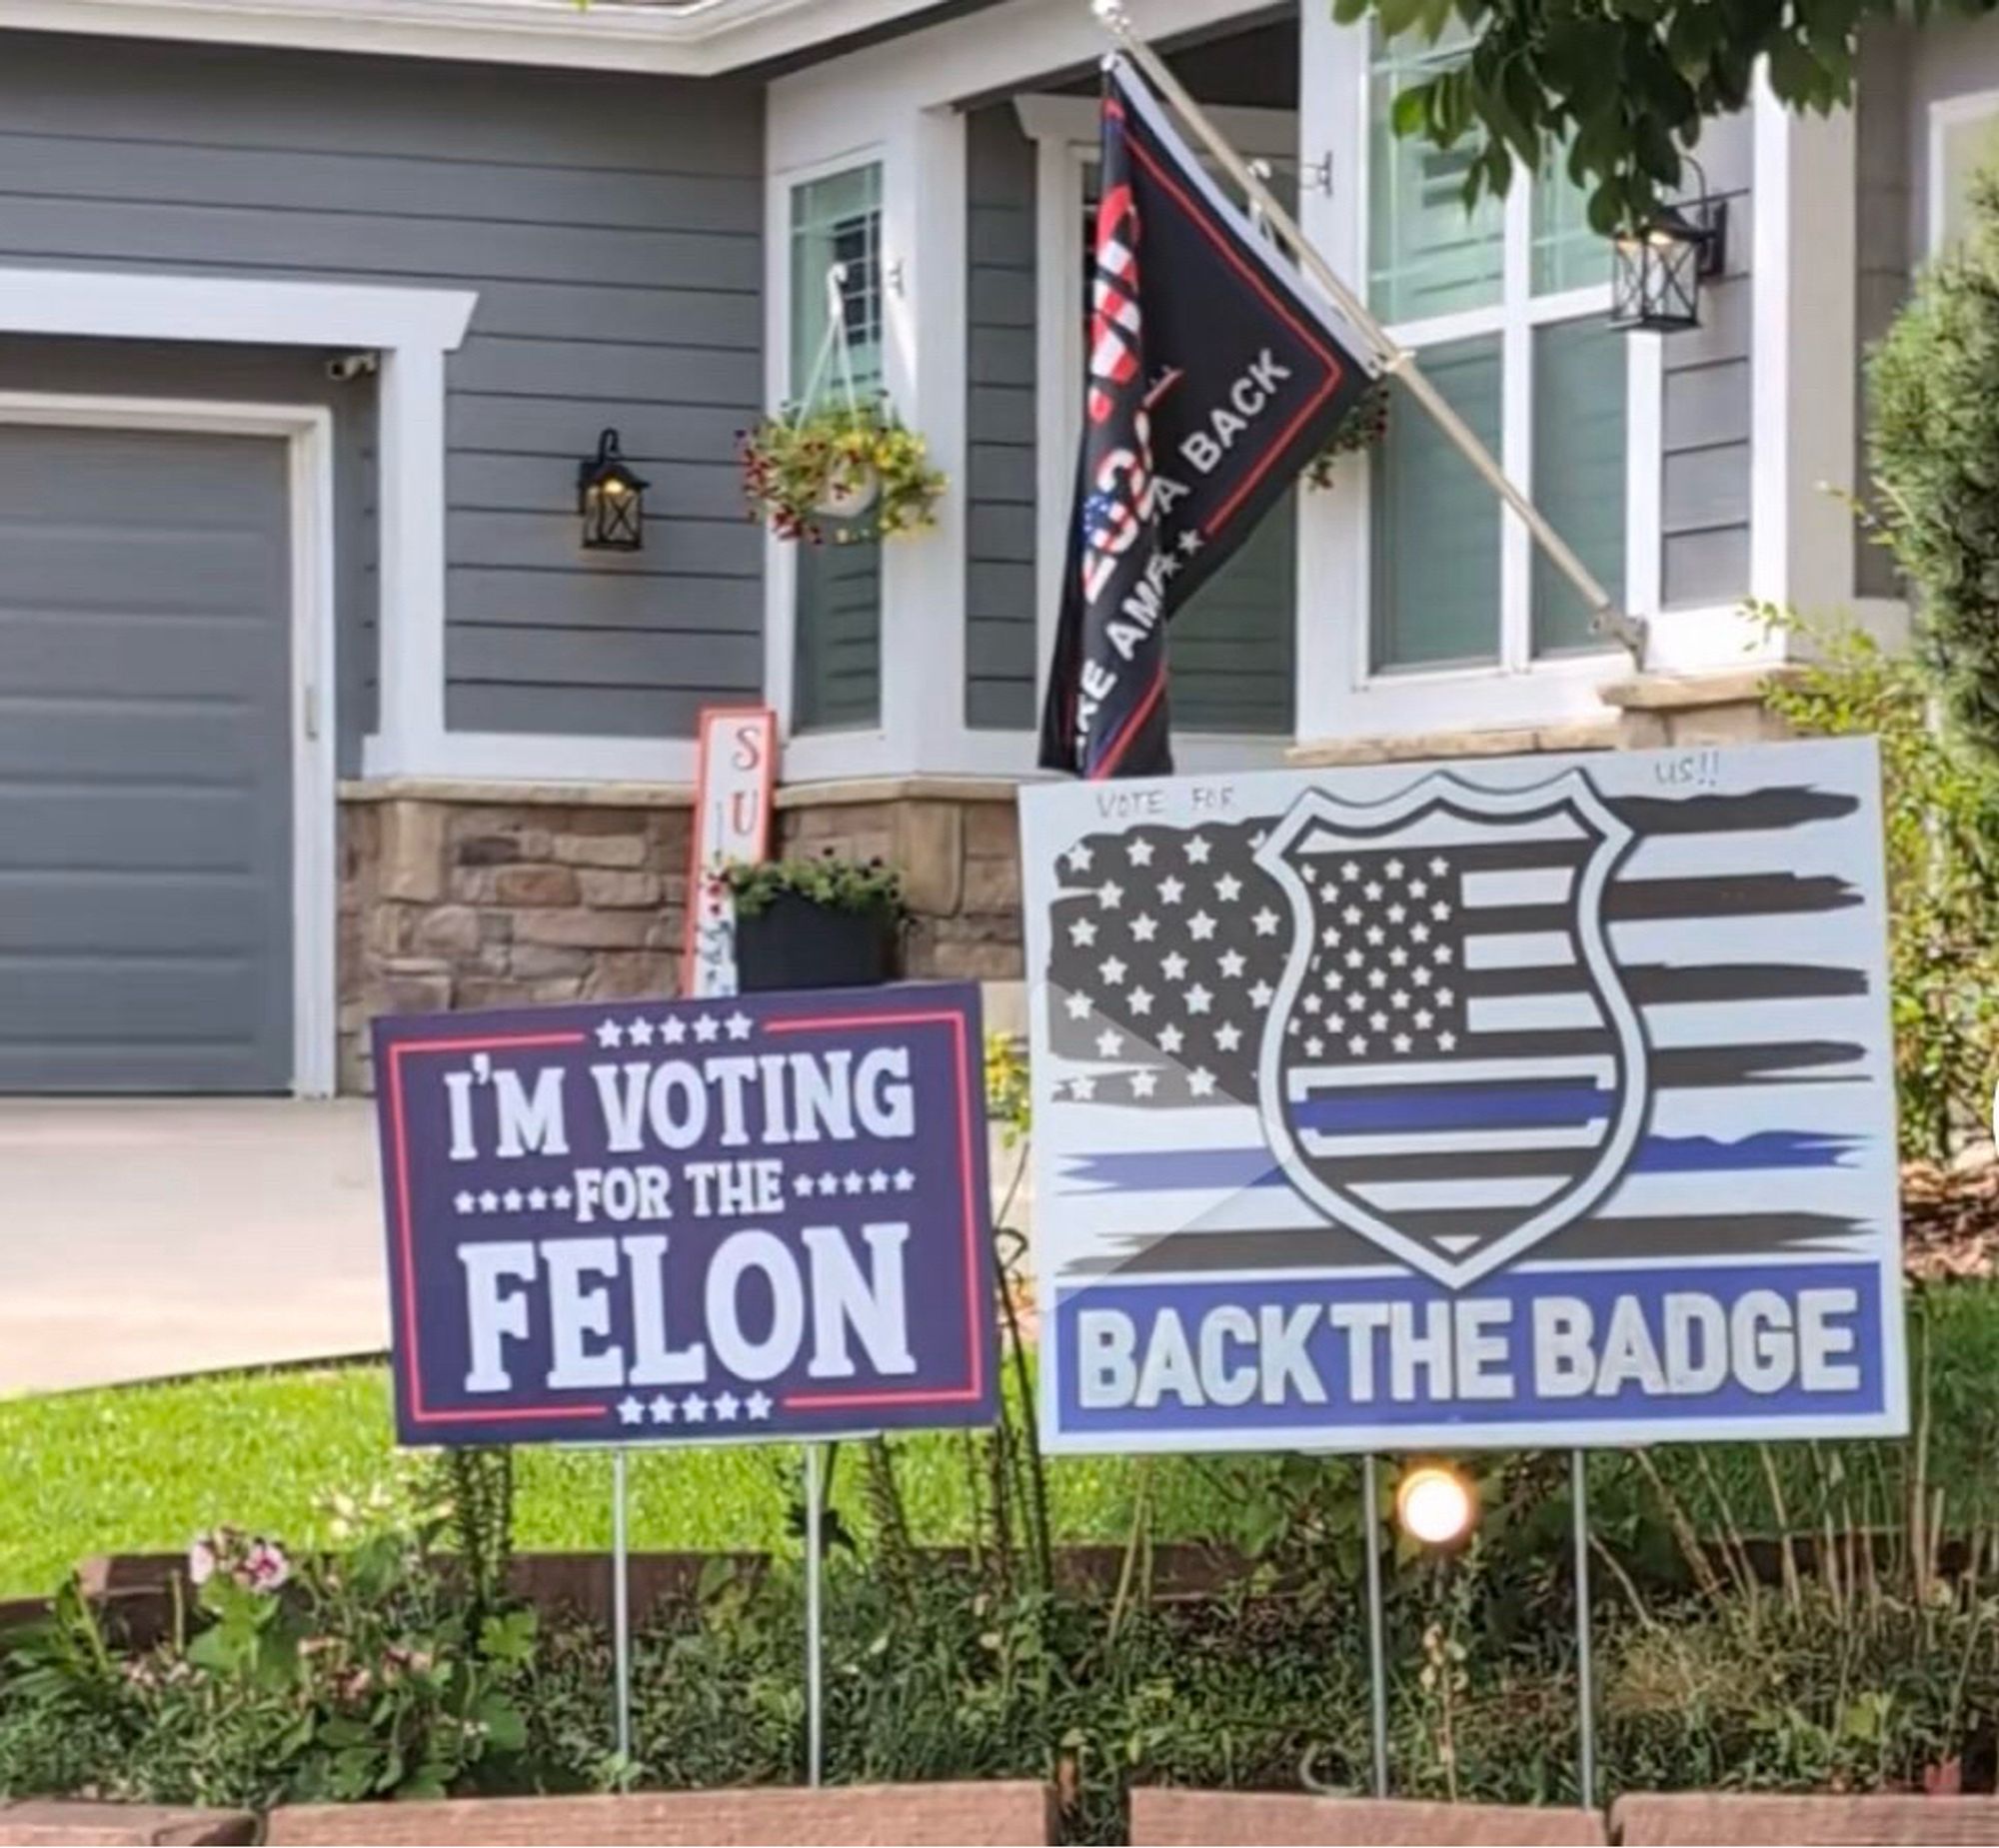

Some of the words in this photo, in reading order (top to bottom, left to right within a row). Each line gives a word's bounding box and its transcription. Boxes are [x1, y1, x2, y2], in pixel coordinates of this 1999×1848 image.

[1178, 348, 1291, 474] BACK
[1096, 789, 1164, 818] VOTE
[444, 1051, 570, 1159] I'M
[591, 1046, 915, 1152] VOTING
[573, 1165, 673, 1222] FOR
[684, 1159, 785, 1217] THE
[457, 1221, 918, 1392] FELON
[1077, 1302, 1331, 1409] BACK
[1333, 1296, 1514, 1401] THE
[1532, 1287, 1861, 1396] BADGE
